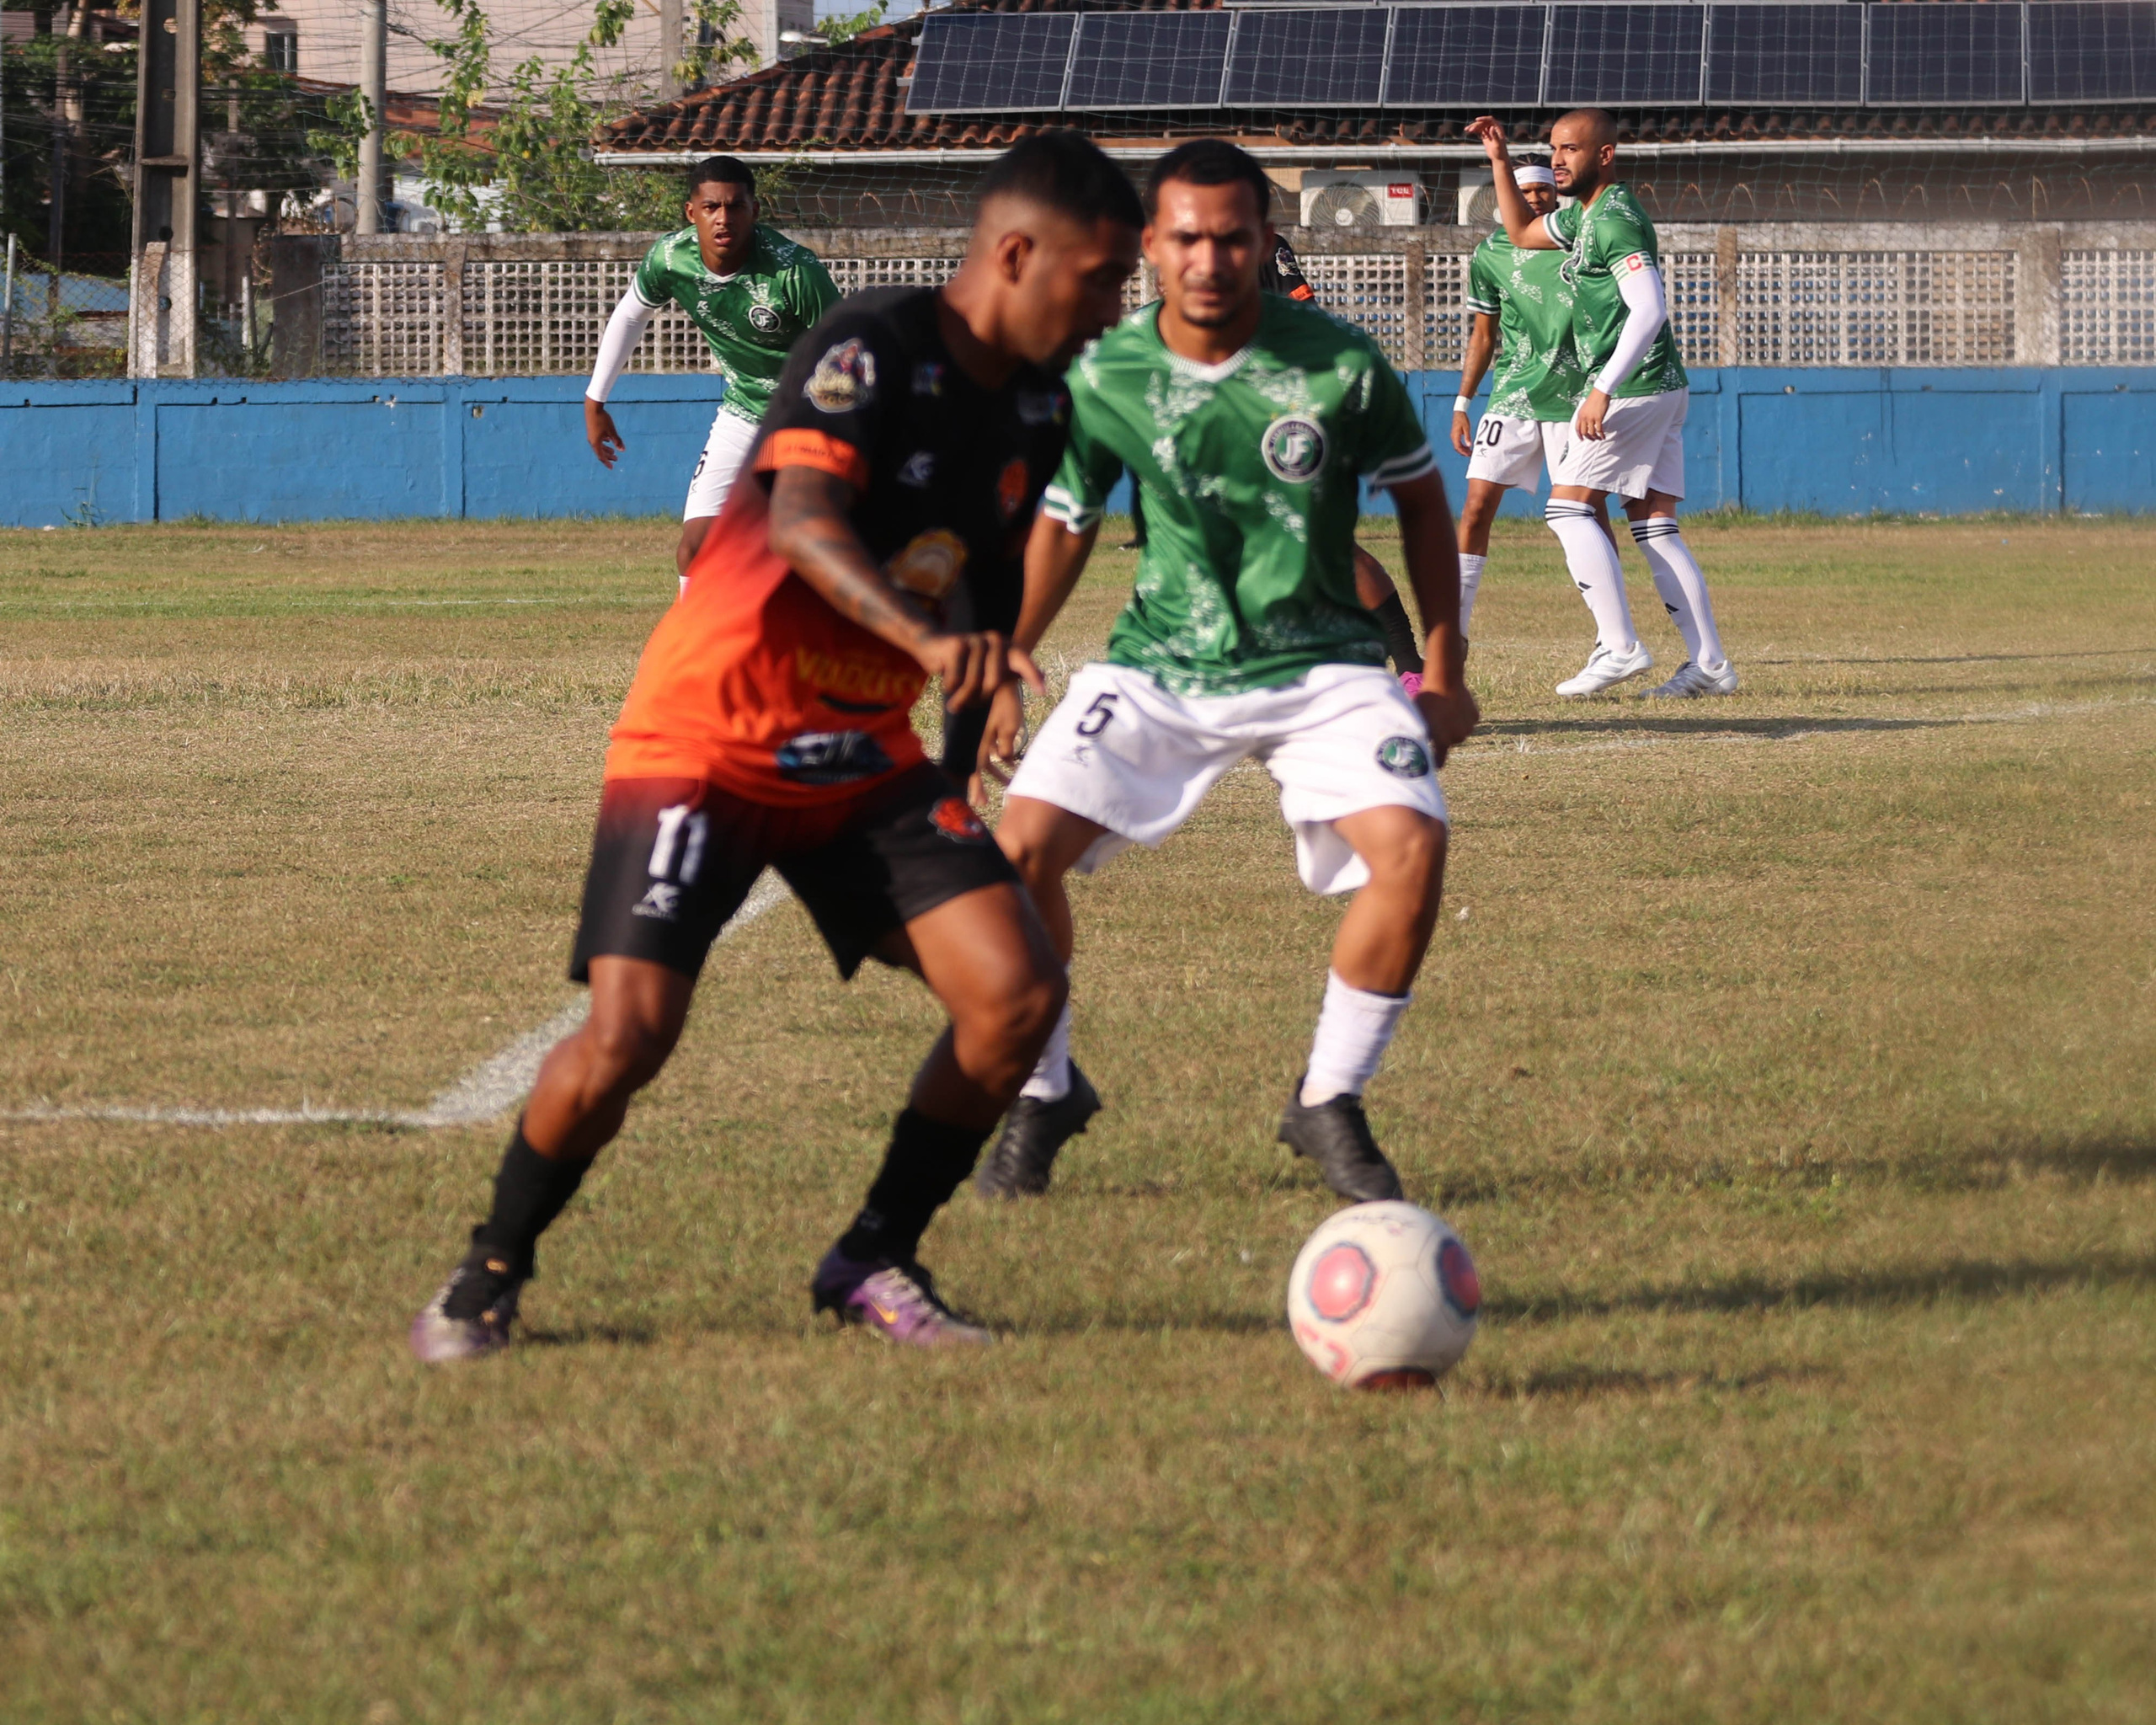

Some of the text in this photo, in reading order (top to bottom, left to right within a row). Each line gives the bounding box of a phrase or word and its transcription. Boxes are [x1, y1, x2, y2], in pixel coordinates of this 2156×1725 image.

[1626, 254, 1642, 271] C
[756, 314, 770, 327] JF
[1476, 419, 1503, 446] 20
[1279, 435, 1310, 465] JF
[1076, 692, 1118, 737] 5
[648, 804, 707, 886] 11
